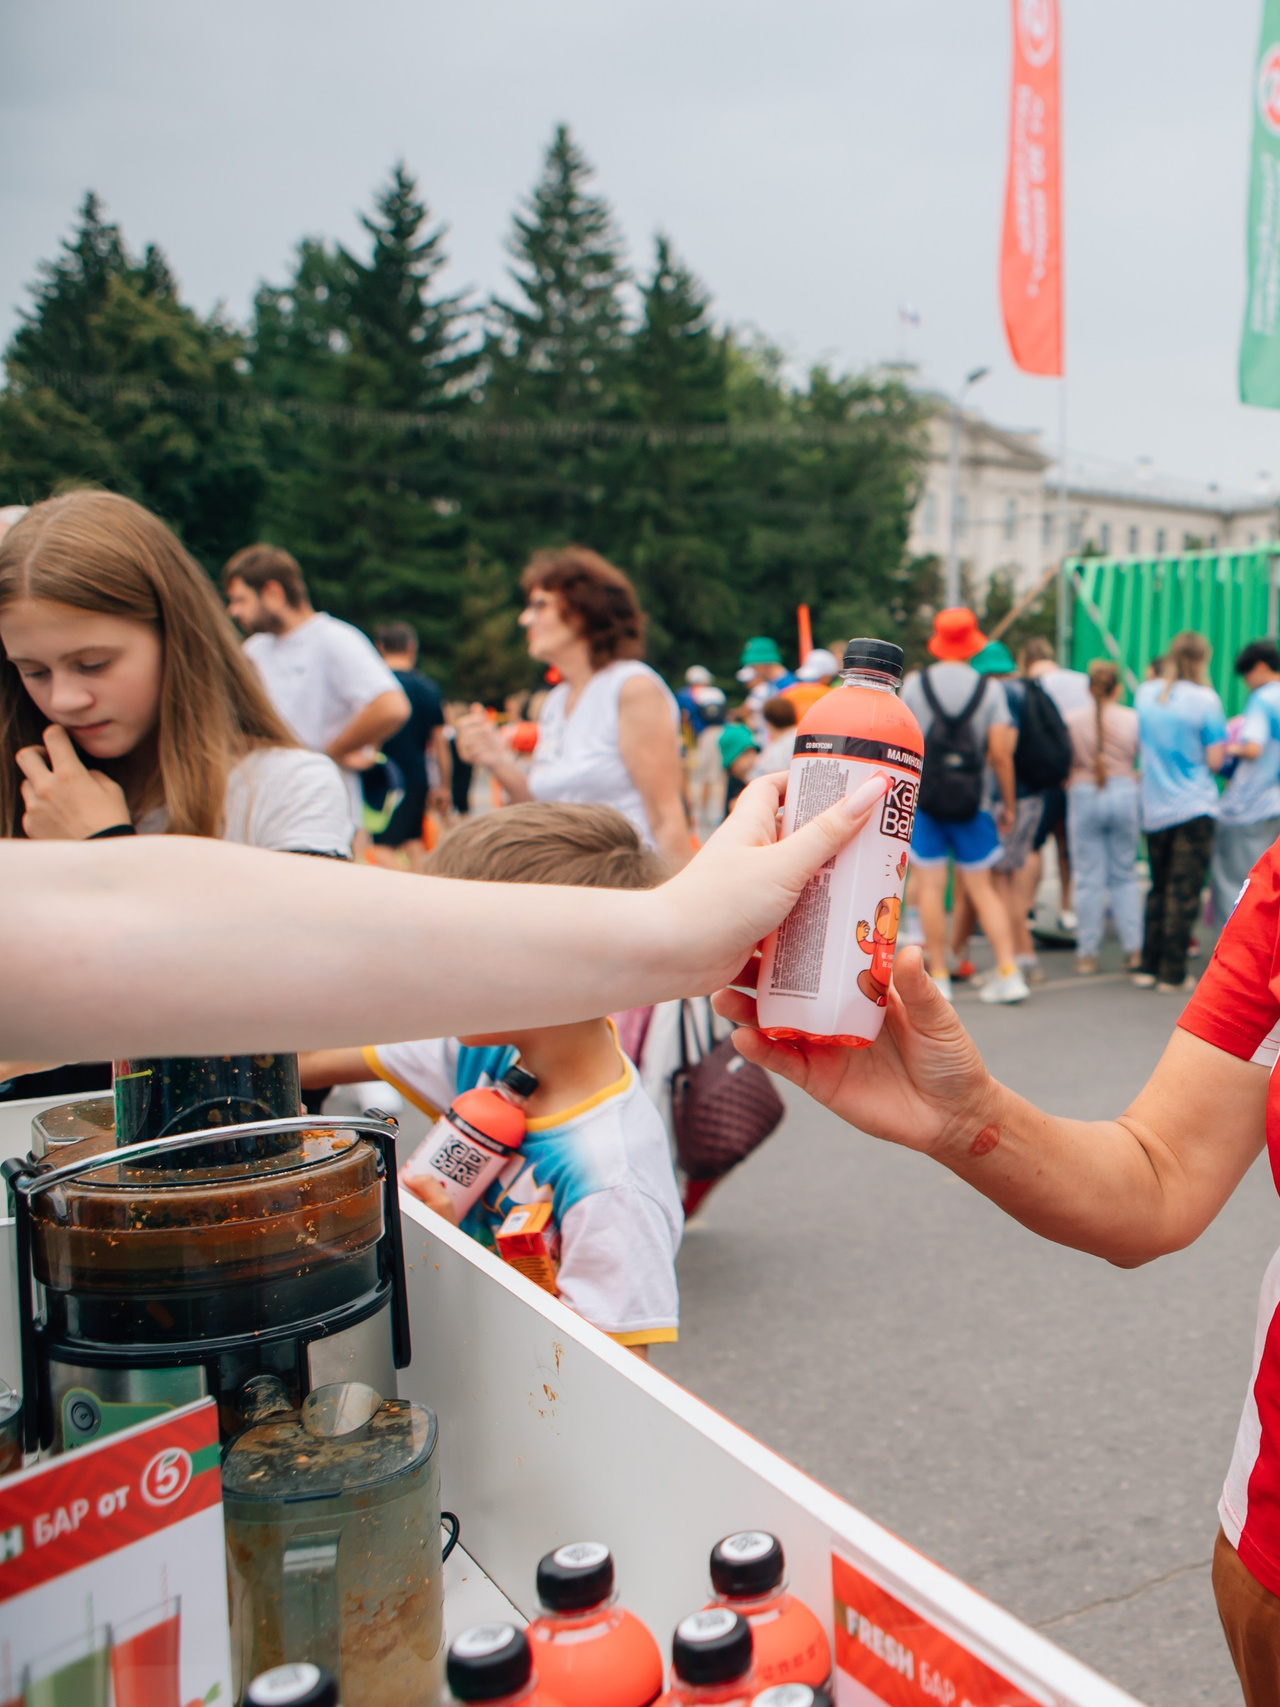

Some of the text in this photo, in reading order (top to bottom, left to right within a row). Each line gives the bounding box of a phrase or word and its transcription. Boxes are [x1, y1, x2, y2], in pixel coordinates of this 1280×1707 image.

[33, 1497, 90, 1549] БАР
[846, 1605, 914, 1682] FRESH
[918, 1660, 956, 1706] БАР
